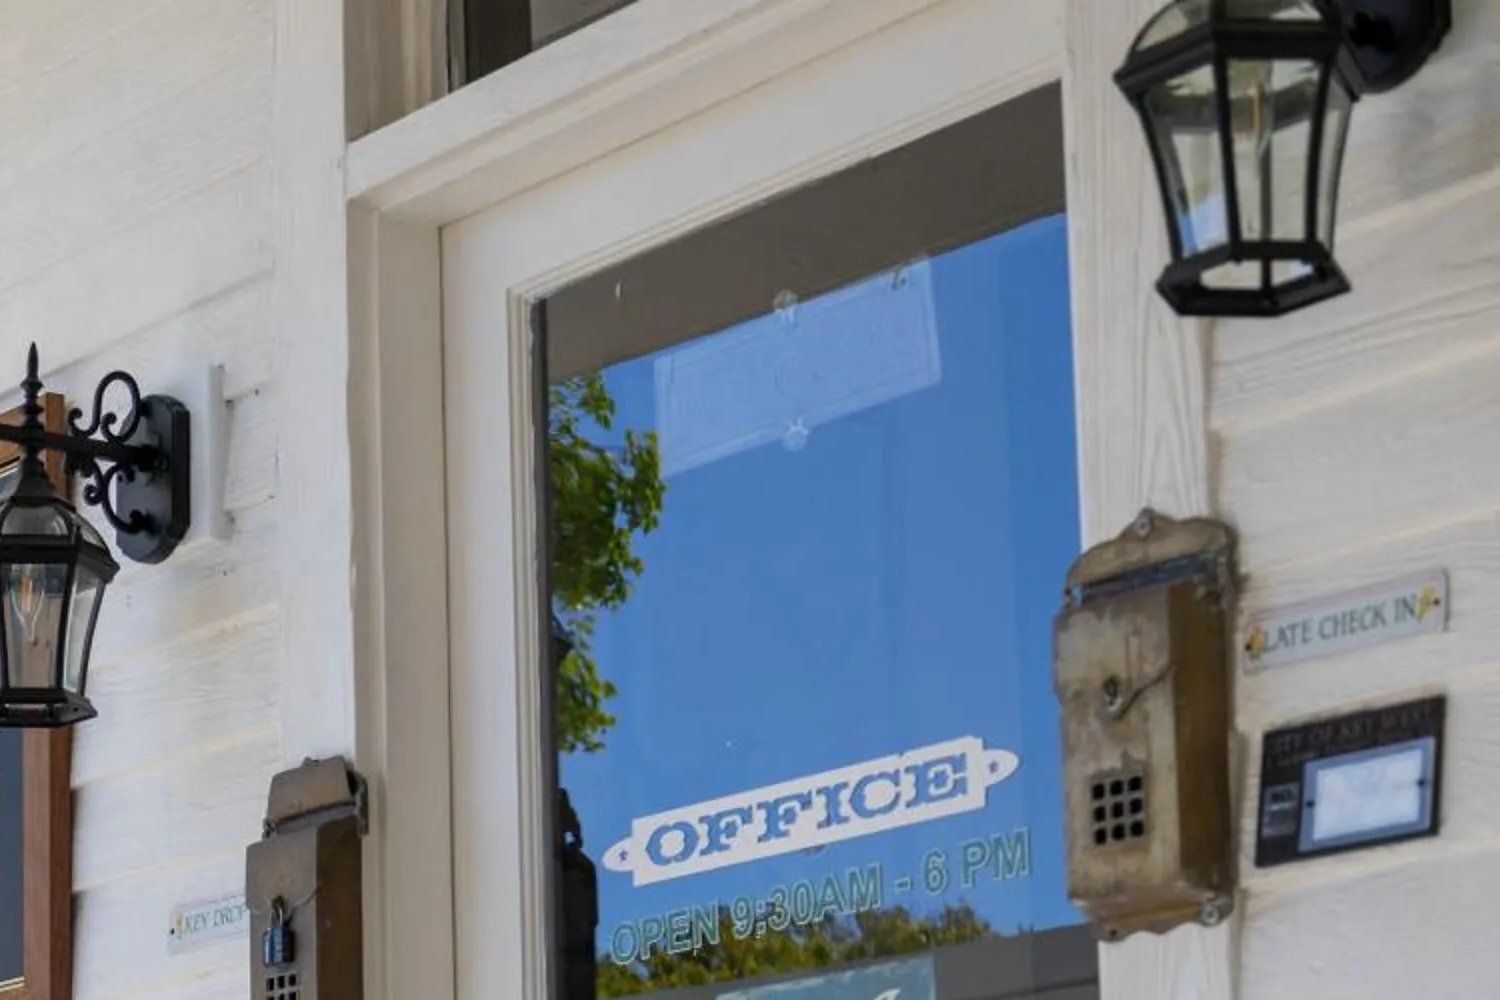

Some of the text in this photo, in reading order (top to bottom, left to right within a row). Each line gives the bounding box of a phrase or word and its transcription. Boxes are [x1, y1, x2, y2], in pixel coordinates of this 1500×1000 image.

[1263, 592, 1418, 652] LATE CHECK IN
[644, 751, 969, 866] OFFICE
[610, 898, 720, 966] OPEN
[730, 863, 884, 940] 9:30AM
[923, 850, 948, 896] 6
[962, 827, 1033, 889] PM
